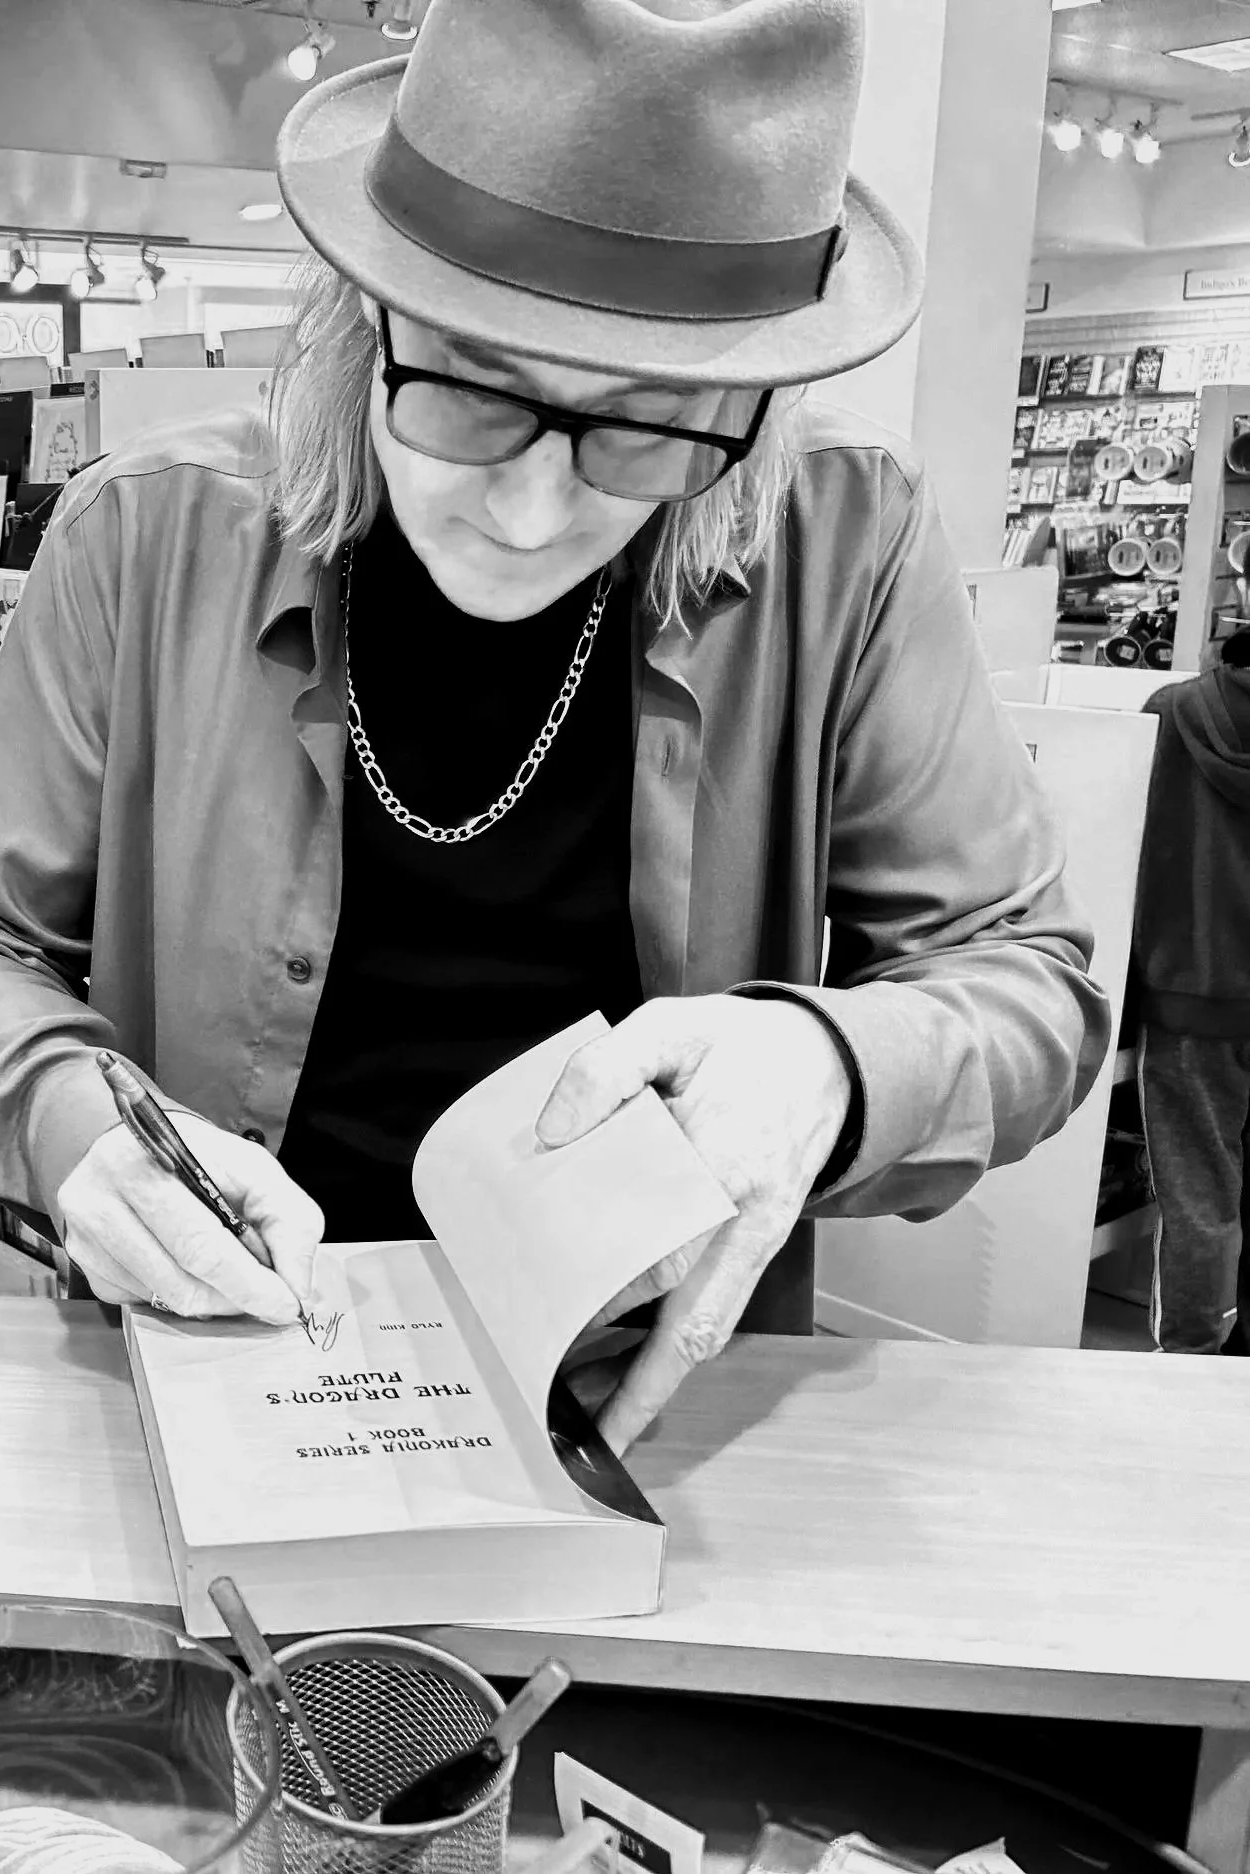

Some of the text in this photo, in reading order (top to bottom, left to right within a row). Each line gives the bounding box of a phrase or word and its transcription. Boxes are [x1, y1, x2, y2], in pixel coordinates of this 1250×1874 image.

[410, 1319, 443, 1330] RYLO
[317, 1371, 404, 1387] FLUTE
[265, 1382, 472, 1405] THE DRAGON'S
[347, 1427, 426, 1442] BOOK 1
[296, 1435, 492, 1458] DRAKONIA SERIES
[275, 1699, 337, 1797] Round Stic M
